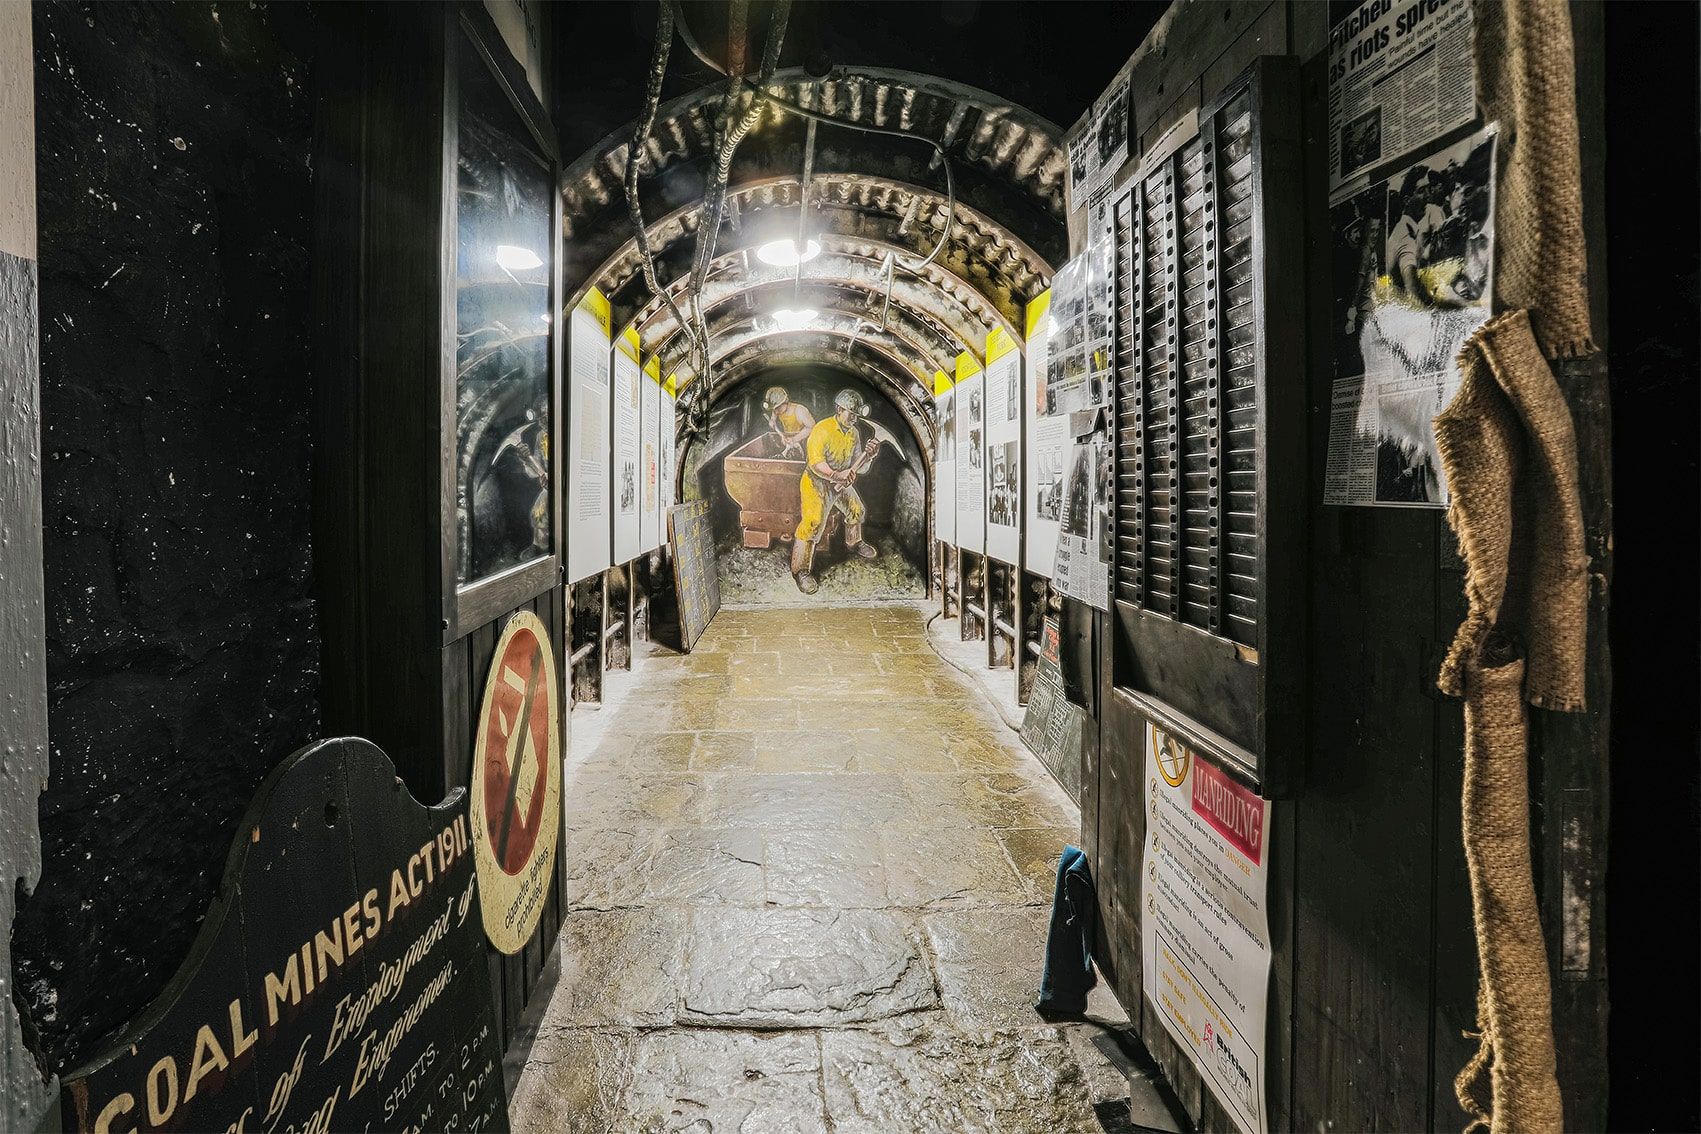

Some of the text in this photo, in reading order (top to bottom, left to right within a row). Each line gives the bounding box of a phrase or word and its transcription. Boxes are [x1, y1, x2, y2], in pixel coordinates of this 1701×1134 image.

[1330, 0, 1450, 86] as riots spre
[1418, 31, 1438, 49] have
[1439, 10, 1468, 35] healed
[1435, 9, 1449, 25] but
[1172, 802, 1193, 825] manriding
[1194, 822, 1207, 838] places
[1208, 835, 1217, 848] you
[1218, 842, 1224, 853] in
[1225, 850, 1250, 875] DANGER
[1194, 765, 1260, 847] MANRIDING
[505, 846, 549, 930] cigarette lighters
[1172, 825, 1193, 847] manriding
[1194, 846, 1212, 867] destroys
[1213, 862, 1222, 875] the
[1223, 873, 1242, 894] mutual
[1243, 894, 1258, 909] trust
[1174, 857, 1195, 882] manriding
[1205, 888, 1223, 908] serious
[1224, 906, 1264, 950] contravention
[517, 877, 542, 939] prohibited
[1171, 888, 1192, 915] manriding
[1219, 943, 1233, 961] gross
[1190, 886, 1212, 912] transport
[1213, 908, 1226, 925] rules
[94, 997, 259, 1134] COAL
[264, 888, 382, 1027] MINES
[387, 840, 435, 921] ACT
[262, 872, 476, 1134] of Employment of
[1208, 966, 1217, 979] the
[1218, 977, 1238, 1005] penalty
[384, 1042, 440, 1123] SHIFTS.
[438, 1073, 454, 1099] TO
[460, 1044, 470, 1071] 2
[444, 1059, 495, 1134] TO 10 P.M.
[1216, 1035, 1251, 1087] British
[1216, 1046, 1256, 1114] COAL
